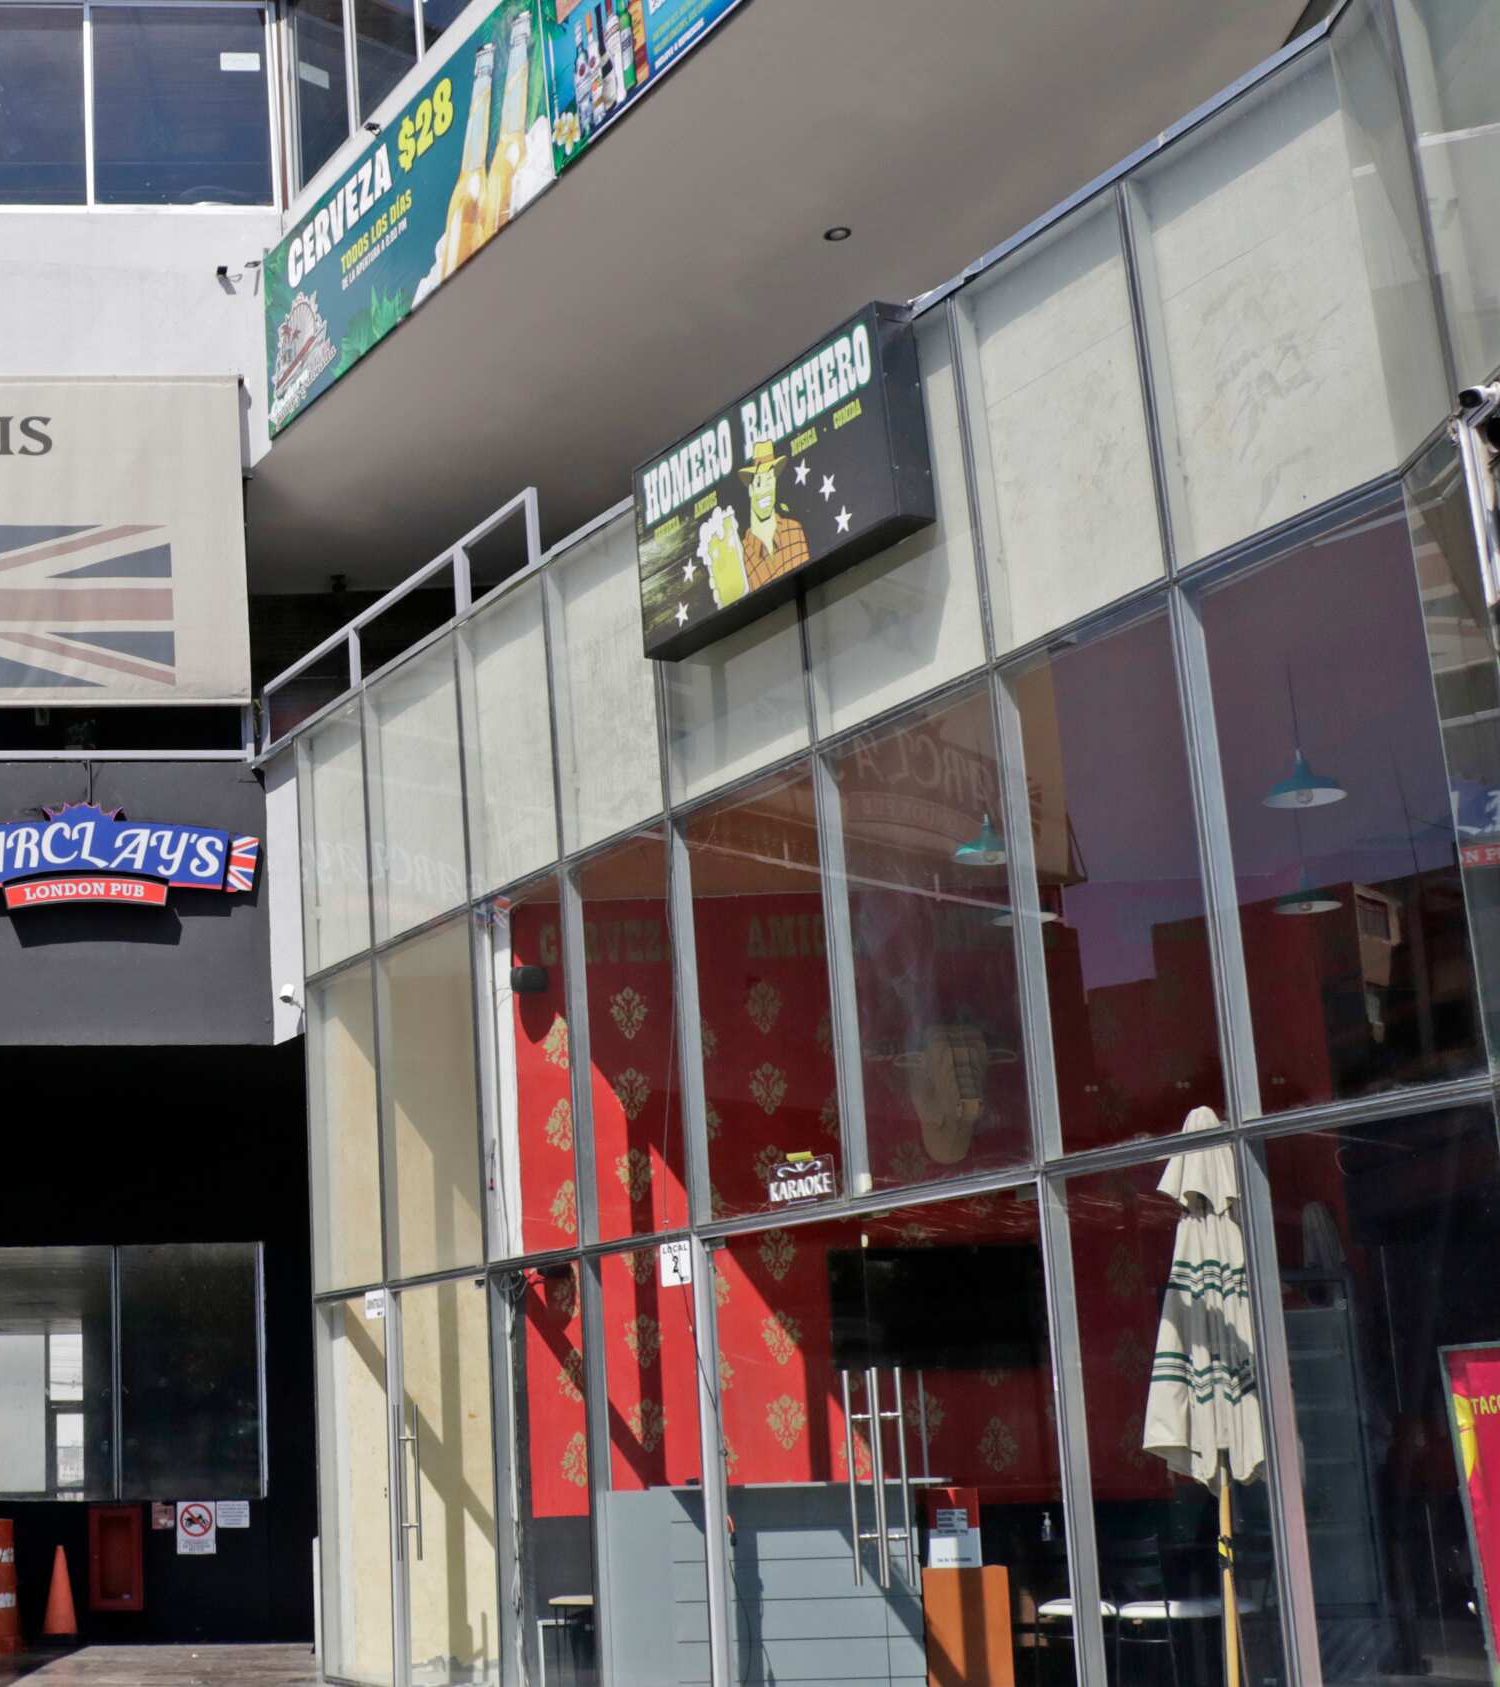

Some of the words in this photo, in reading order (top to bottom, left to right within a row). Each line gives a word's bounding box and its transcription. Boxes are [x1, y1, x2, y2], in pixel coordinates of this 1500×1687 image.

[398, 78, 454, 173] $28
[288, 143, 393, 288] CERVEZA
[341, 231, 369, 274] TODOS
[371, 212, 388, 244] LOS
[389, 188, 412, 225] DÍAS
[643, 419, 733, 527] HOMERO
[740, 324, 871, 460] RANCHERO
[24, 885, 104, 900] LONDON
[110, 883, 145, 898] PUB
[769, 1172, 833, 1202] KARAOKE
[662, 1244, 688, 1255] LOCAL
[672, 1255, 679, 1273] 2
